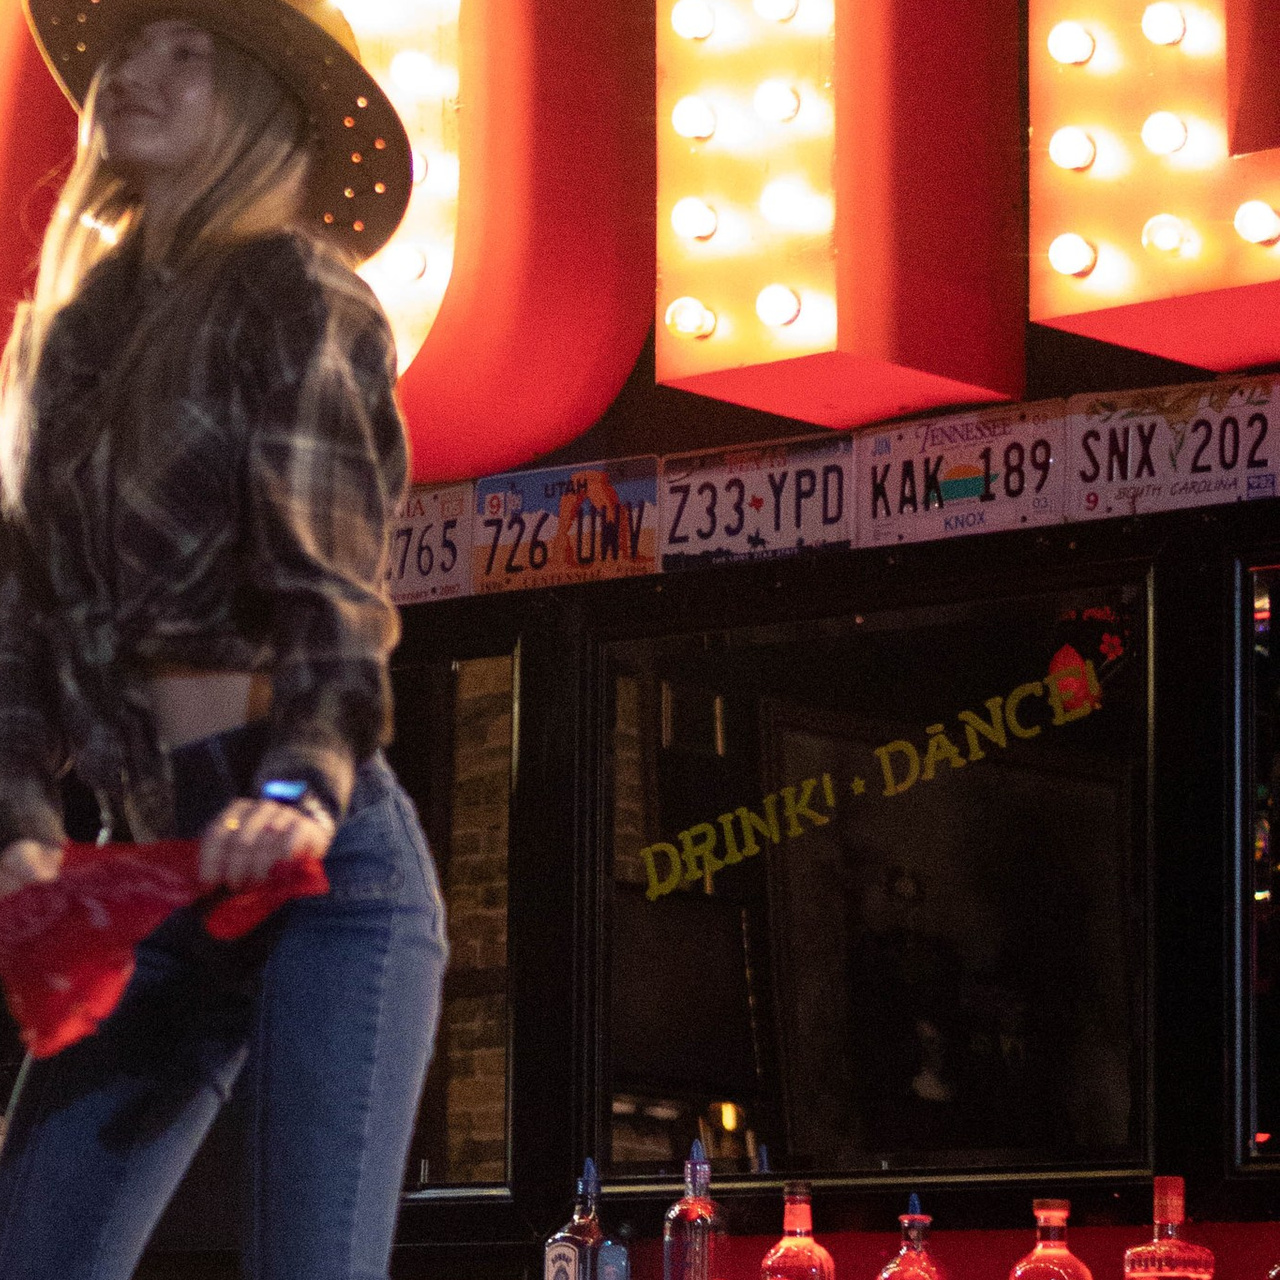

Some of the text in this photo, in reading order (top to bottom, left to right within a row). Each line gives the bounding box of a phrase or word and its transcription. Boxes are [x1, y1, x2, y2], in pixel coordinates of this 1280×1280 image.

[915, 417, 1012, 453] TENNESSEE
[1080, 413, 1268, 483] SNX 202
[544, 479, 588, 499] UTAH
[871, 439, 1051, 519] KAK 189
[1085, 492, 1099, 511] 9
[1115, 485, 1161, 500] SOUTH
[1171, 477, 1238, 496] CAROLINA
[489, 494, 501, 515] 9
[669, 464, 844, 544] Z33 YPD
[944, 514, 985, 531] KNOX
[387, 519, 457, 579] 765
[484, 514, 548, 575] 726
[641, 773, 835, 901] DRINK!
